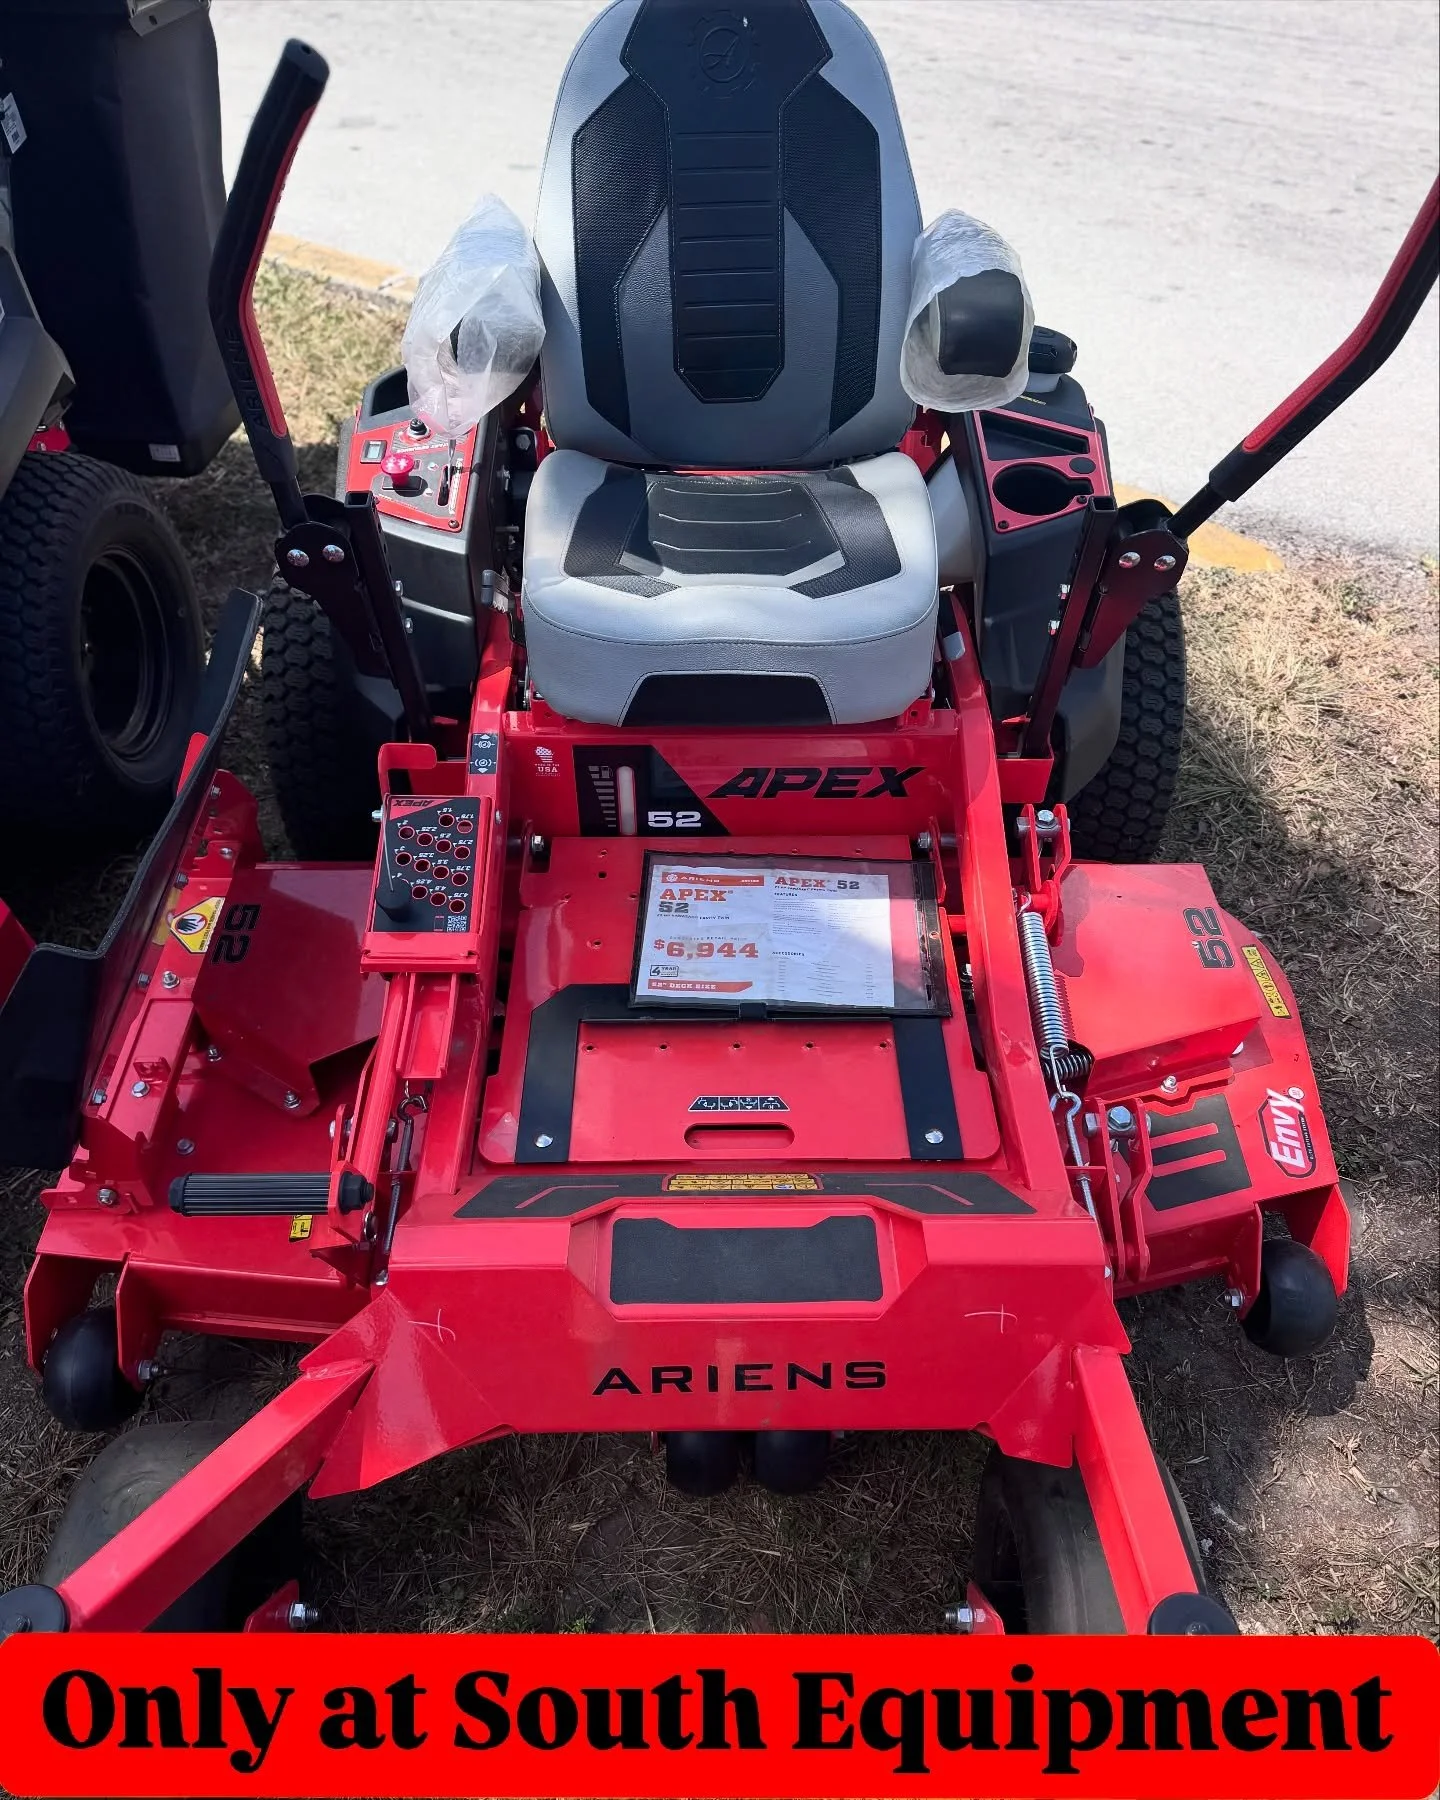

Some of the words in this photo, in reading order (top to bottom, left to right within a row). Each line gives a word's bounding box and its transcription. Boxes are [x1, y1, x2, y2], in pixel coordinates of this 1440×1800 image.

[705, 766, 928, 799] APEX
[647, 811, 702, 828] 52
[837, 880, 860, 890] 52
[658, 901, 690, 914] 52
[212, 904, 261, 964] 52
[653, 939, 759, 960] $6,944
[1183, 907, 1235, 968] 52
[1266, 1087, 1306, 1168] Envy
[592, 1361, 887, 1396] ARIENS
